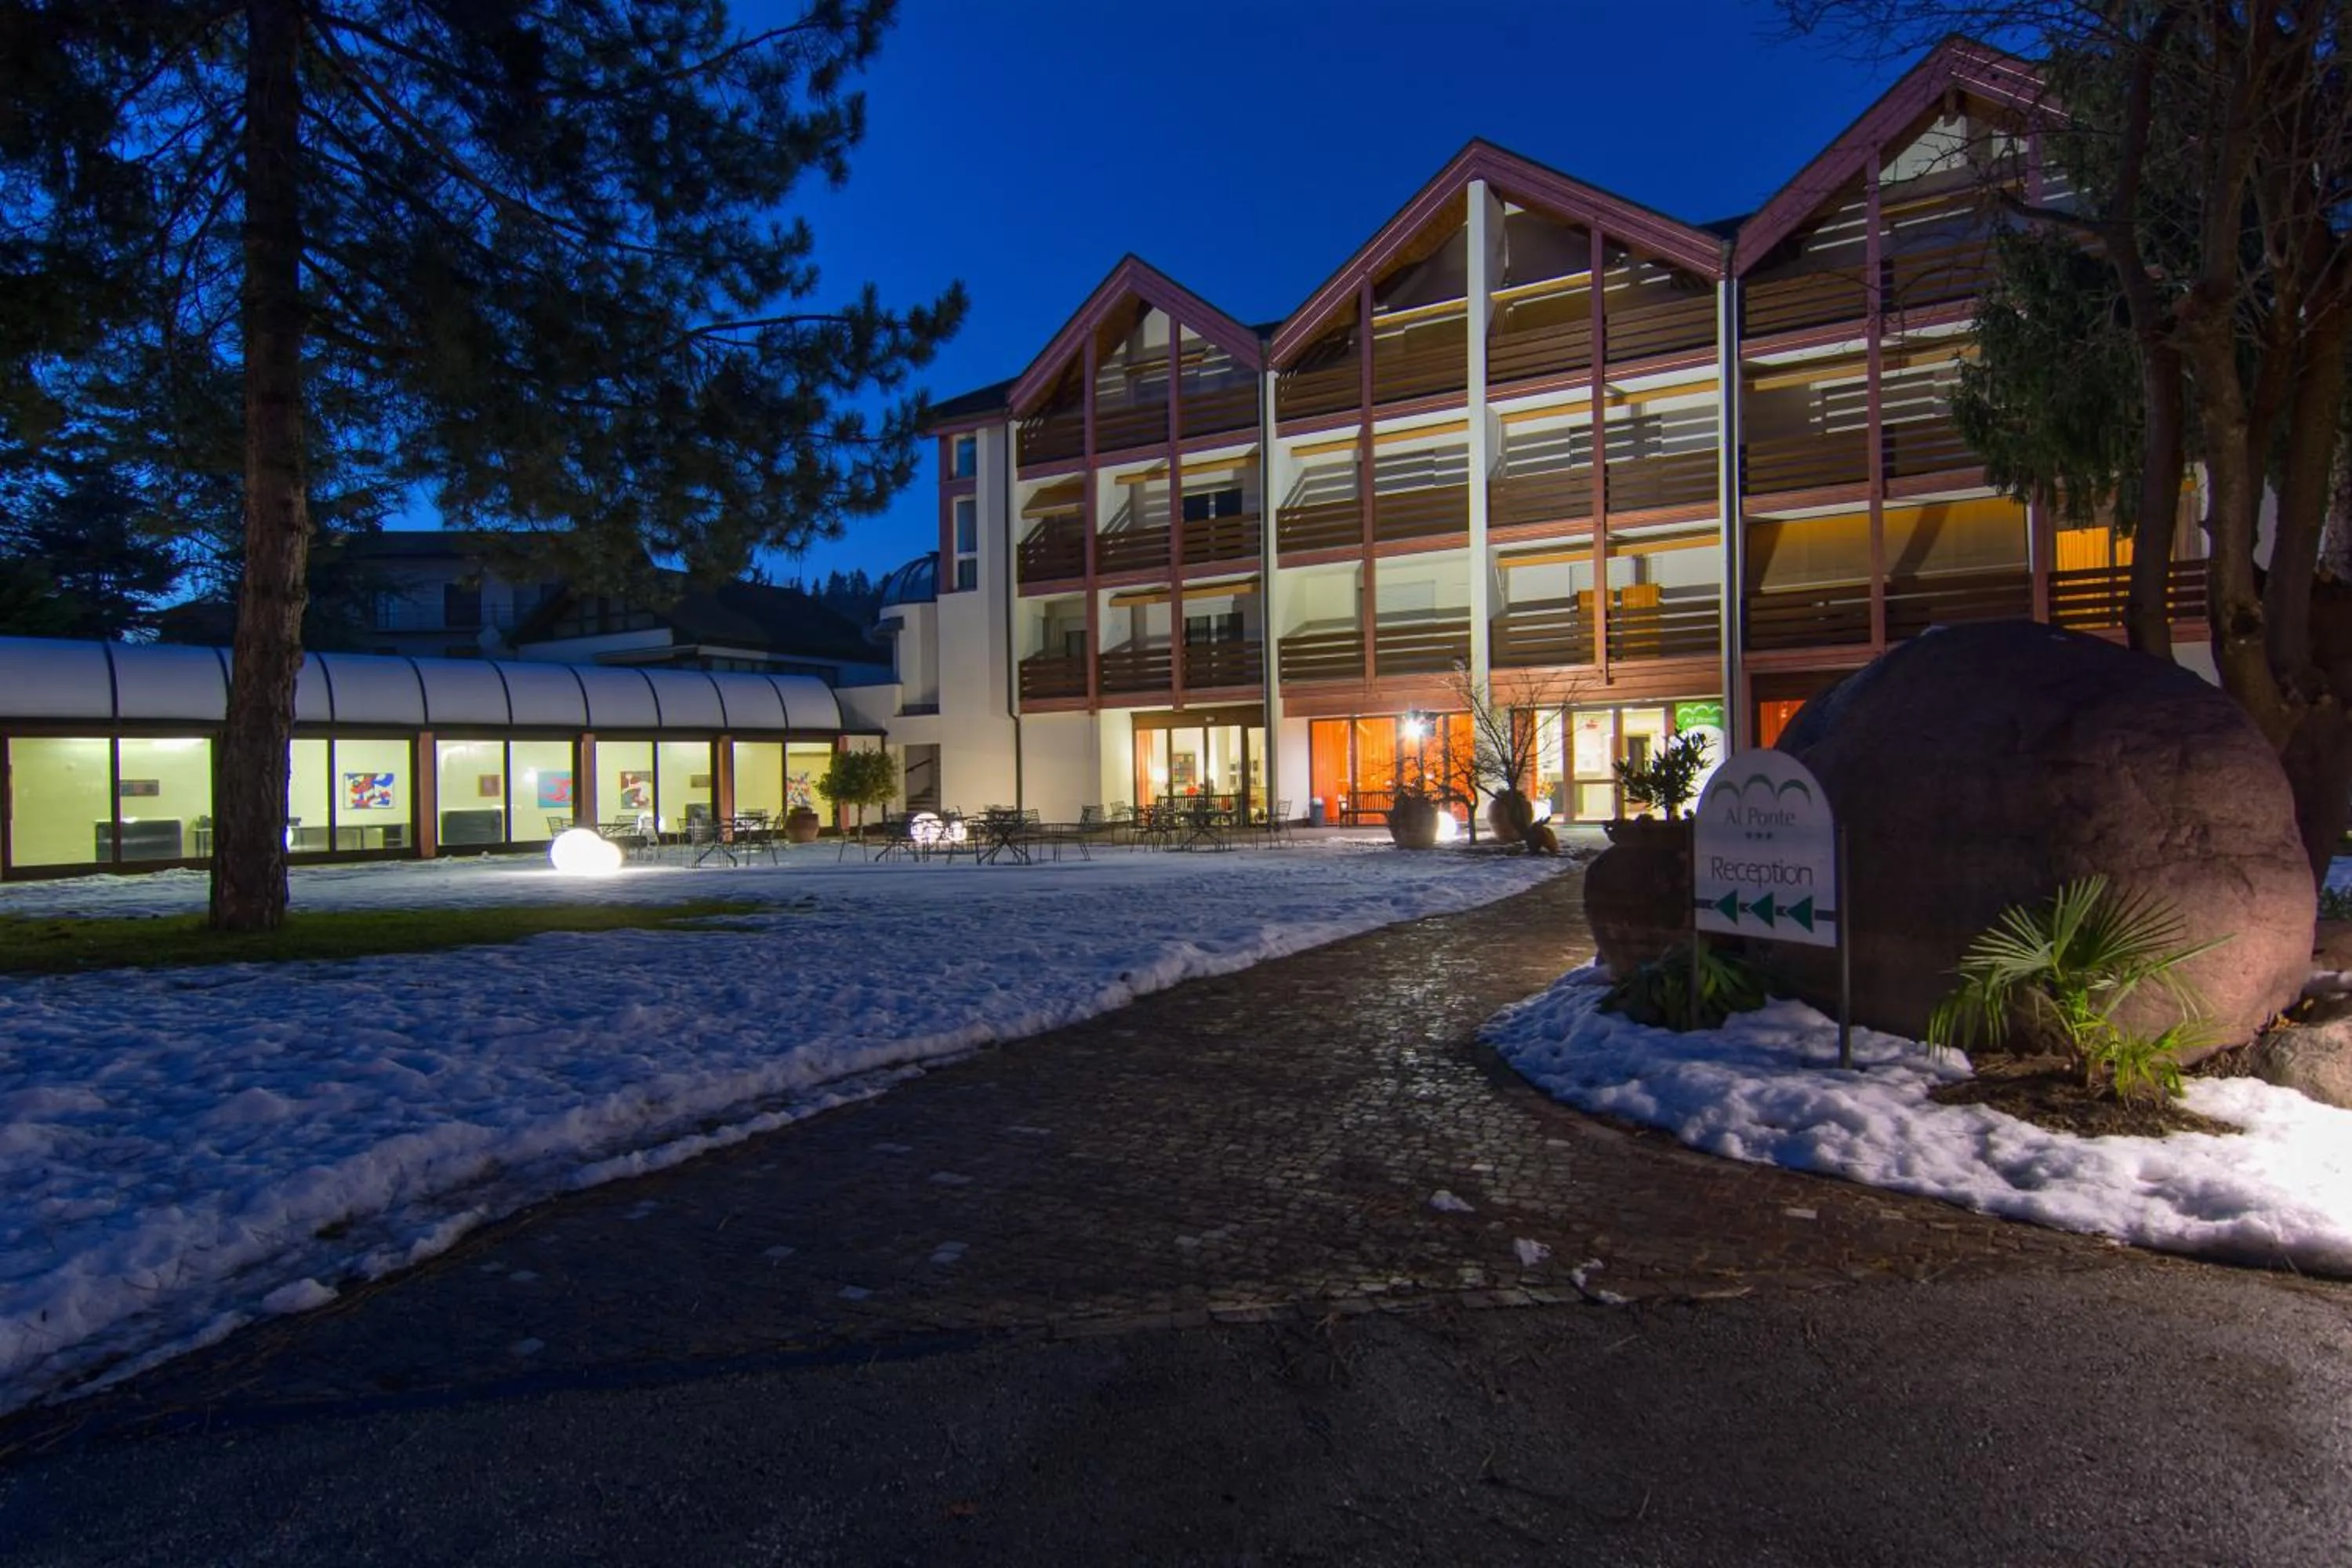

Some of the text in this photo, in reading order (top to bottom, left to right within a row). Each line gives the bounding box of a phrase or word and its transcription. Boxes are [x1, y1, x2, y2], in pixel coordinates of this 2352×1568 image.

[1724, 807, 1796, 826] Al Ponte
[1711, 855, 1813, 888] Reception
